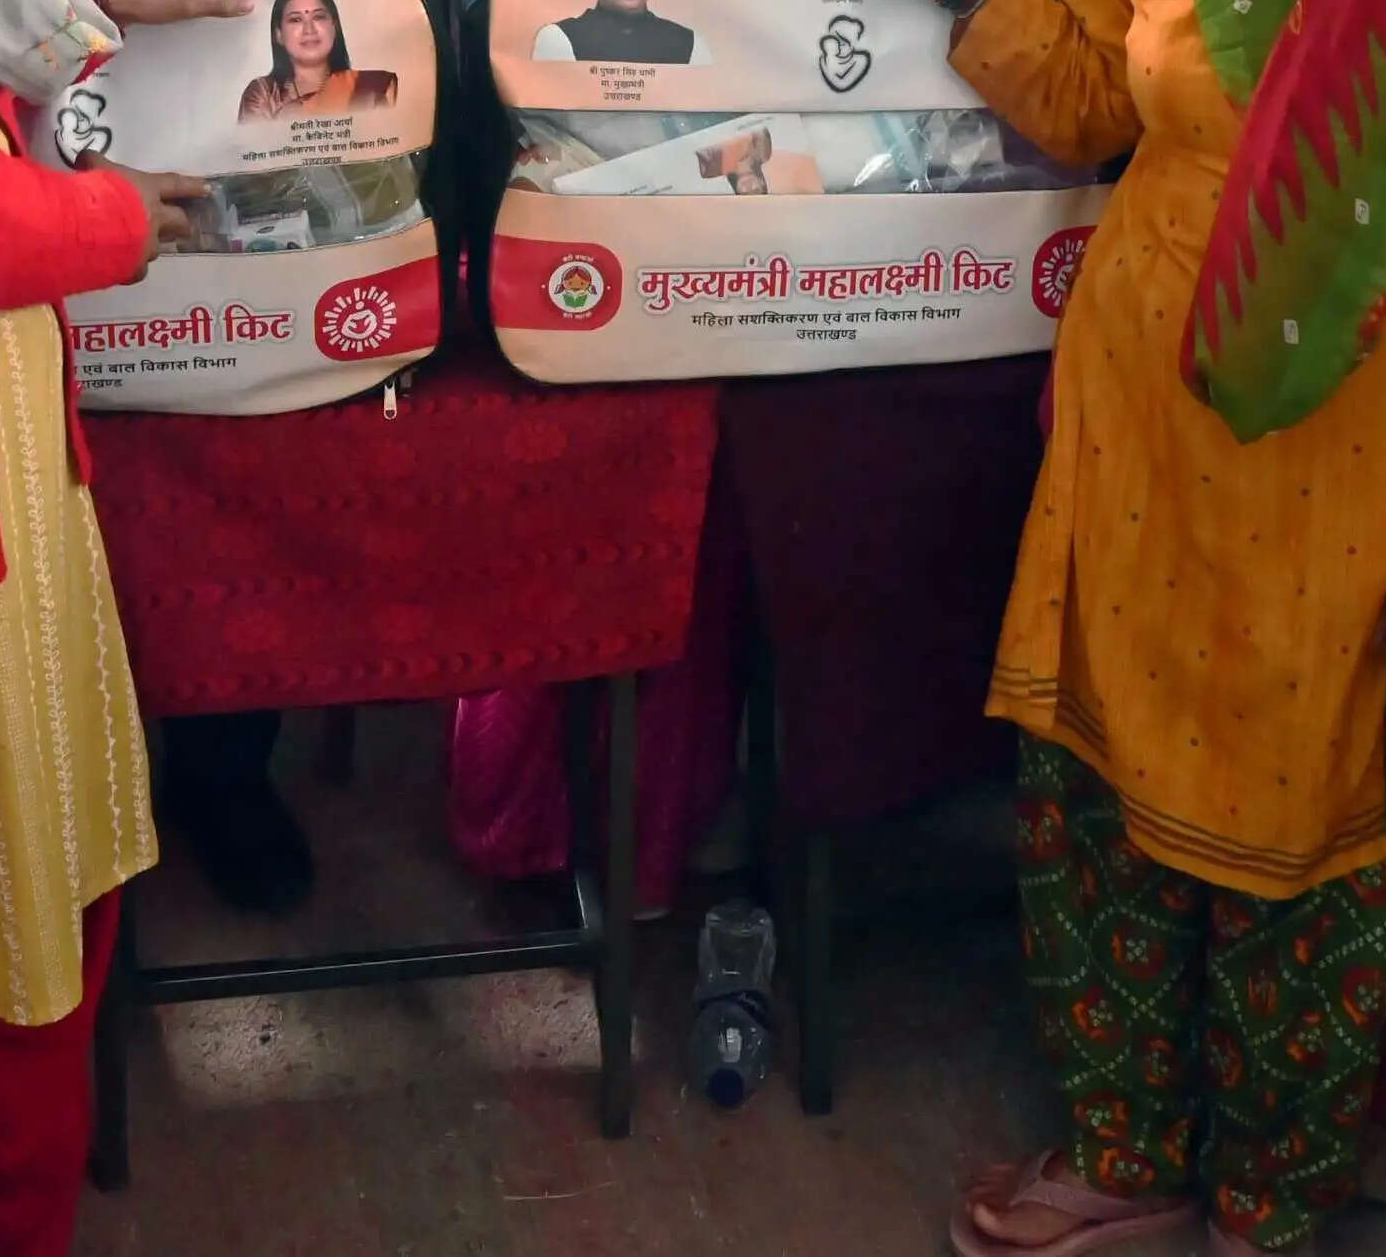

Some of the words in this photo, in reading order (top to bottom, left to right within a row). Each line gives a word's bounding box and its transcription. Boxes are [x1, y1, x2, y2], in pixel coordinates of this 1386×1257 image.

[641, 257, 790, 310] मुख्यमंत्री
[800, 251, 942, 299] महालक्ष्मी
[952, 250, 1014, 291] किट
[223, 304, 291, 342] किट
[692, 312, 734, 327] महिला
[738, 310, 818, 326] सशक्तिकरण
[823, 310, 842, 325] एवं
[846, 311, 870, 323] बाल
[875, 309, 917, 322] विकास
[922, 307, 960, 320] विभाग
[796, 328, 856, 341] उत्तराखण्ड
[83, 360, 103, 375] एवं
[109, 363, 135, 374] बाल
[141, 359, 187, 372] विकास
[194, 357, 237, 369] विभाग
